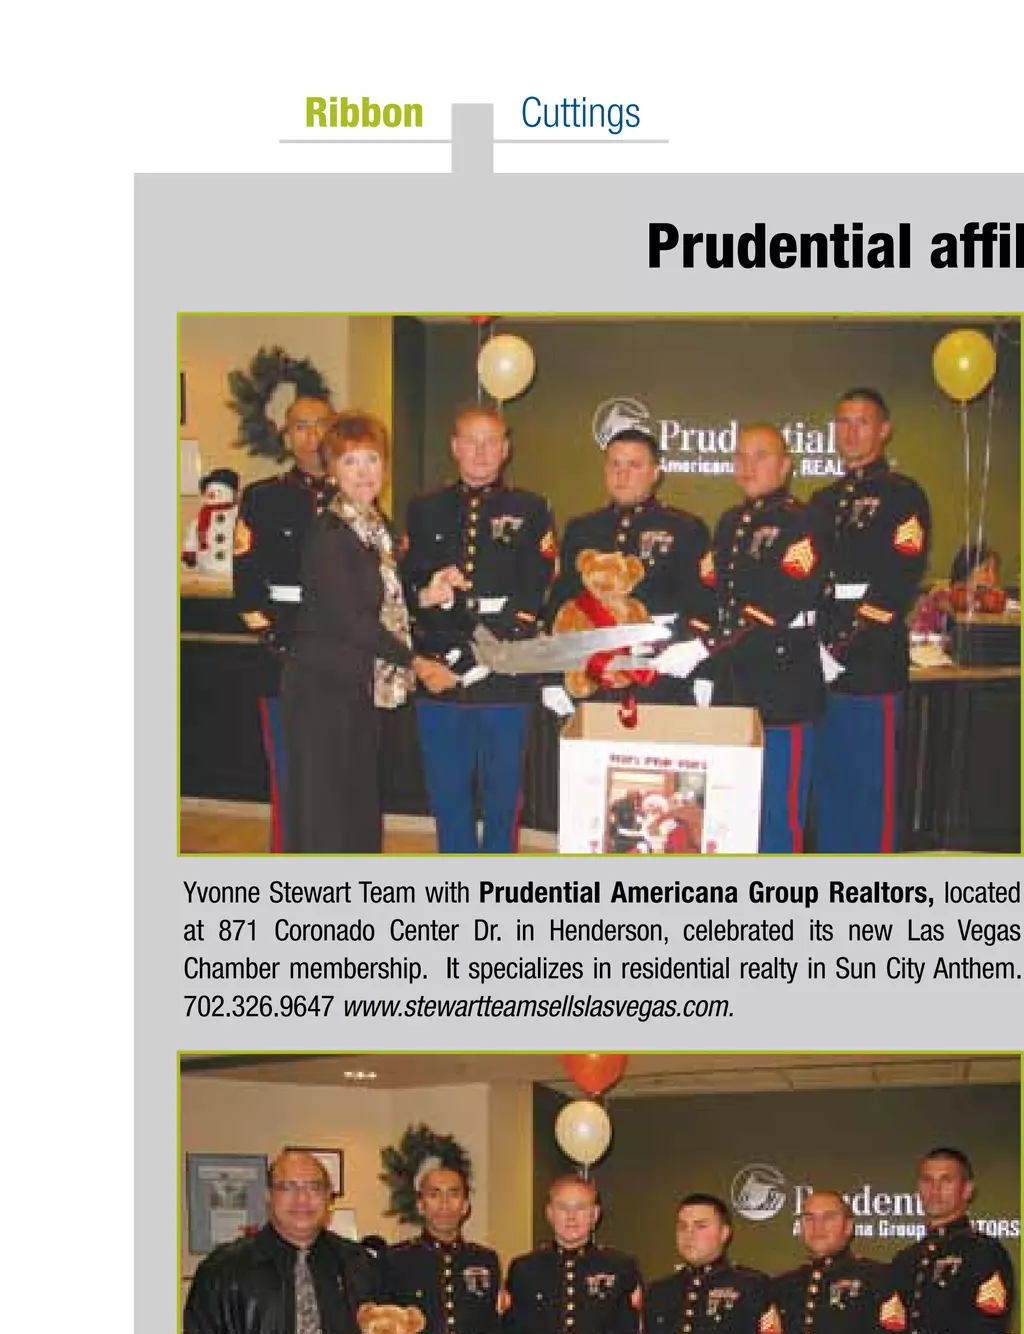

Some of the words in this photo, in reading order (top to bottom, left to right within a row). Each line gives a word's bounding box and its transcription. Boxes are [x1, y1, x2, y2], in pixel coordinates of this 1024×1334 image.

[306, 96, 423, 128] Ribbon
[522, 96, 640, 135] Cuttings
[649, 222, 910, 269] Prudential
[659, 419, 837, 453] Prudtial
[183, 881, 260, 903] Yvonne
[270, 881, 351, 903] Stewart
[358, 881, 415, 903] Team
[425, 881, 469, 903] with
[480, 881, 600, 903] Prudential
[611, 881, 737, 903] Americana
[749, 881, 818, 908] Group
[830, 881, 933, 907] Realtors,
[945, 881, 1020, 903] located
[184, 995, 334, 1017] 702.326.9647
[345, 995, 733, 1022] www.stewartteamsellslasvegas.com.
